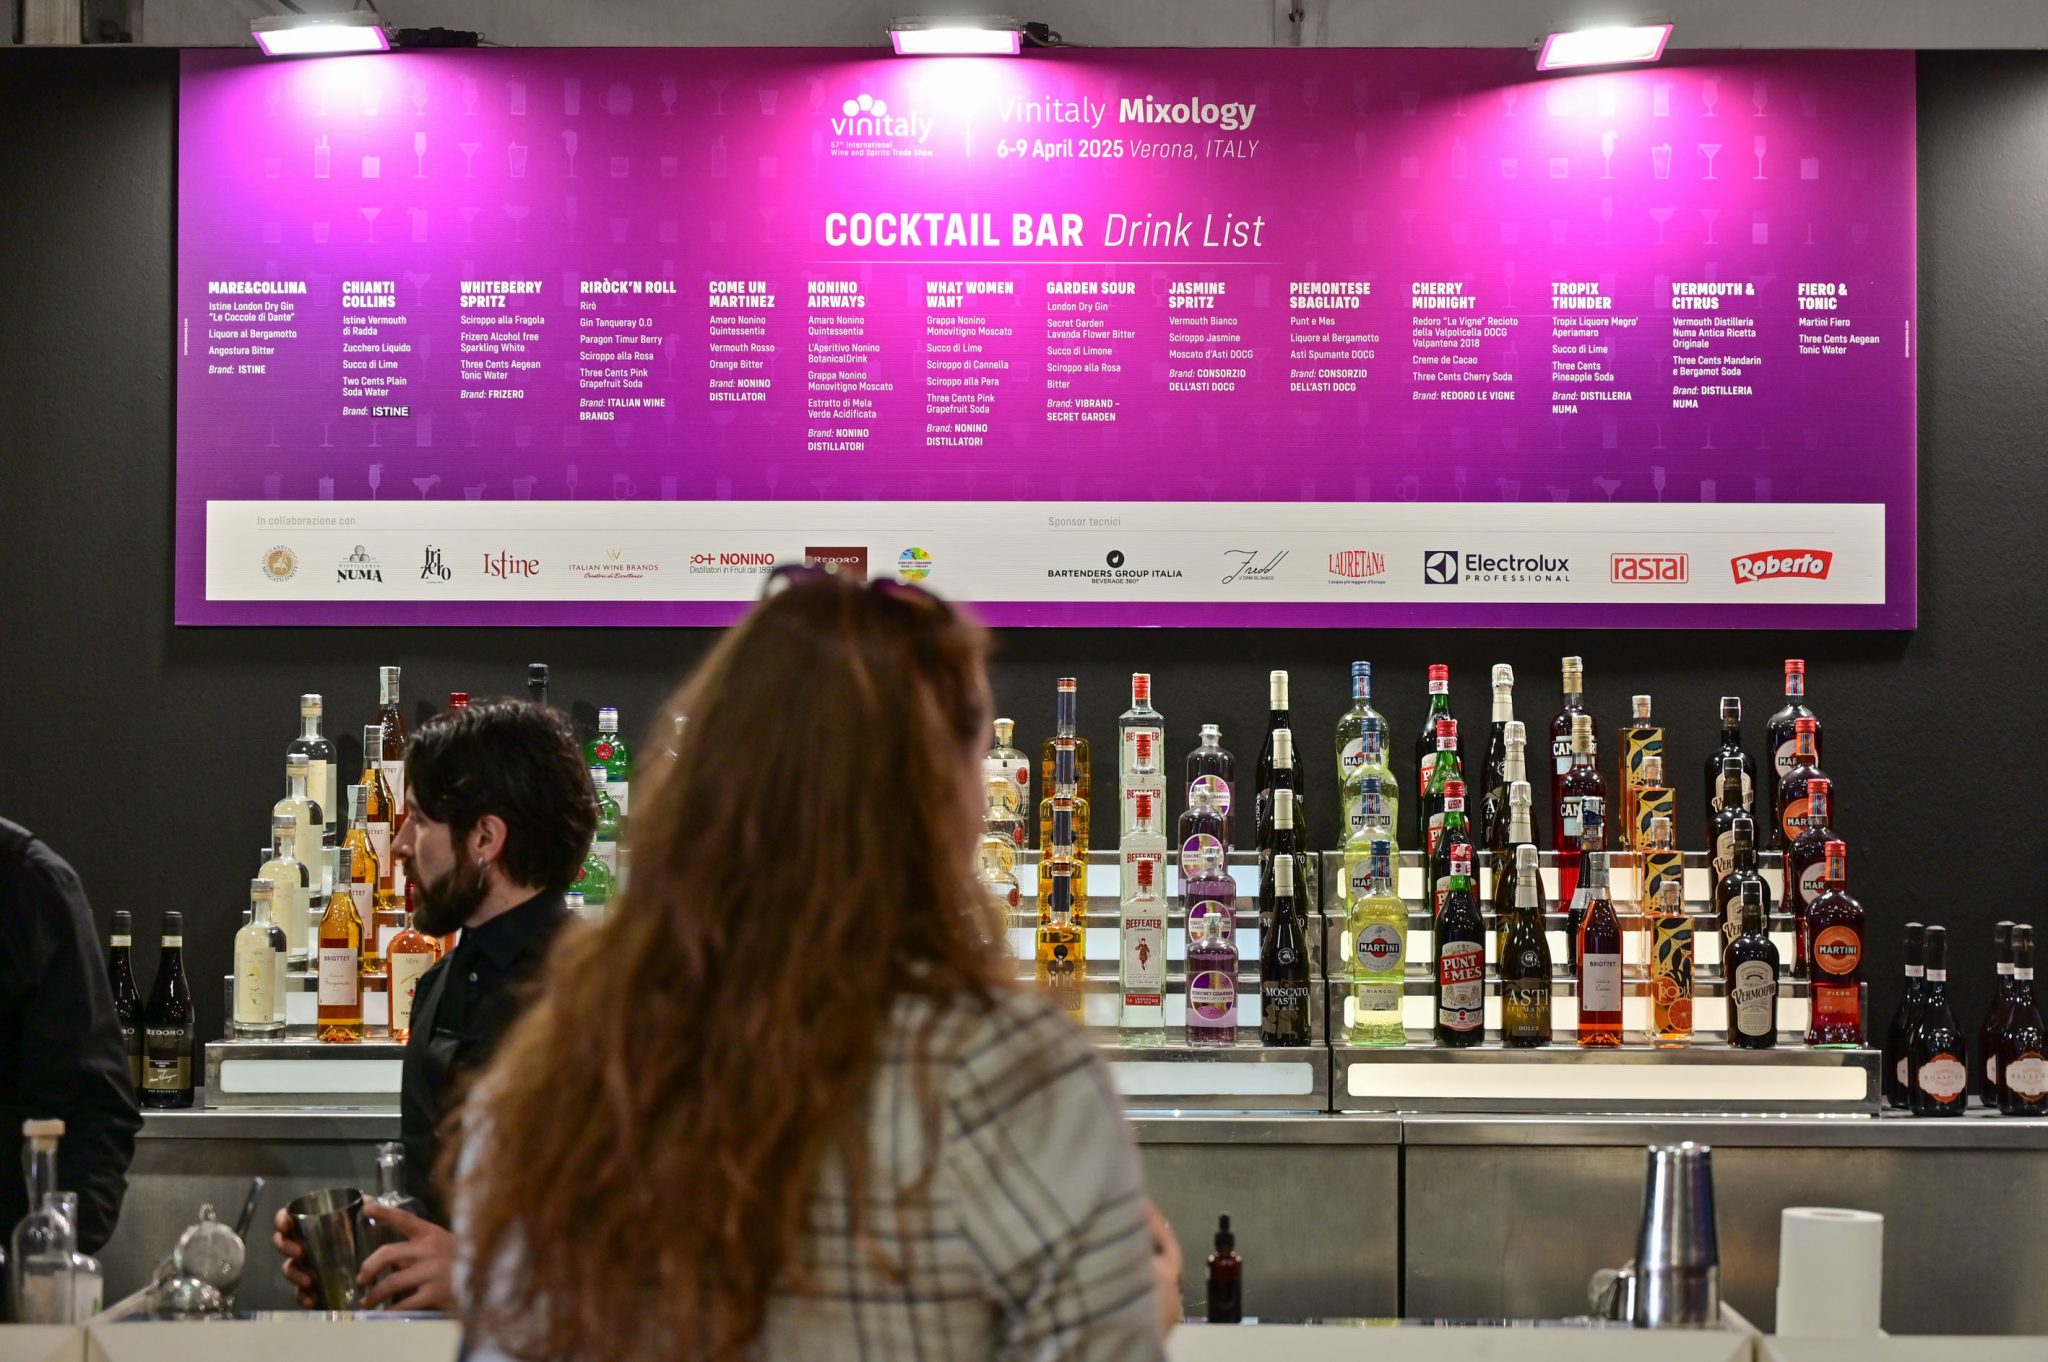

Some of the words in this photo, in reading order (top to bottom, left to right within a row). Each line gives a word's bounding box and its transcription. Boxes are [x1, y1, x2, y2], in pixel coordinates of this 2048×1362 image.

[1119, 94, 1256, 131] Mixology
[831, 111, 933, 143] vinitaly
[831, 149, 849, 157] Wine
[850, 149, 864, 157] and
[866, 149, 890, 158] Spirits
[892, 149, 912, 157] Trade
[914, 149, 934, 157] Show
[997, 139, 1028, 157] 6-9
[1032, 139, 1073, 161] April
[1078, 139, 1124, 158] 2025
[1130, 140, 1197, 160] Verona,
[1206, 140, 1259, 157] ITALY
[826, 213, 1000, 246] COCKTAIL
[1013, 214, 1083, 246] BAR
[1104, 213, 1192, 246] Drink
[1203, 213, 1265, 247] List
[209, 281, 307, 294] MARE&COLLINA
[343, 281, 394, 294] CHIANTI
[460, 281, 542, 293] WHITEBERRY
[645, 281, 676, 293] ROLL
[709, 281, 745, 293] COME
[749, 281, 766, 293] UN
[808, 281, 857, 293] NONINO
[925, 281, 963, 294] WHAT
[965, 282, 1013, 294] WOMEN
[1047, 282, 1098, 294] GARDEN
[1101, 282, 1135, 294] SOUR
[1169, 282, 1225, 294] JASMINE
[1290, 282, 1370, 294] PIEMONTESE
[1412, 282, 1463, 294] CHERRY
[1552, 283, 1599, 295] TROPIX
[1672, 283, 1742, 295] VERMOUTH
[1745, 283, 1754, 295] &
[1798, 283, 1835, 295] FIERO
[1838, 283, 1847, 295] &
[208, 301, 232, 311] Istine
[233, 301, 262, 311] London
[264, 301, 279, 313] Dry
[280, 301, 294, 311] Gin
[343, 295, 396, 307] COLLINS
[460, 295, 505, 307] SPRITZ
[709, 295, 775, 307] MARTINEZ
[808, 296, 865, 308] AIRWAYS
[925, 295, 963, 308] WANT
[1047, 301, 1076, 312] London
[1078, 301, 1093, 313] Dry
[1094, 301, 1108, 312] Gin
[1169, 296, 1214, 308] SPRITZ
[1290, 296, 1359, 308] SBAGLIATO
[1411, 296, 1476, 309] MIDNIGHT
[1552, 297, 1611, 309] THUNDER
[1672, 297, 1719, 309] CITRUS
[1798, 297, 1837, 309] TONIC
[460, 315, 496, 326] Sciroppo
[497, 315, 513, 325] alla
[514, 315, 544, 327] Fragola
[579, 317, 593, 328] Gin
[595, 317, 636, 329] Tanqueray
[638, 317, 652, 328] 0.0
[1290, 316, 1309, 326] Punt
[1311, 318, 1316, 326] e
[1318, 316, 1335, 326] Mes
[1798, 317, 1828, 327] Martini
[1829, 317, 1850, 327] Fiero
[342, 342, 380, 353] Zucchero
[381, 342, 411, 354] Liquido
[709, 342, 748, 353] Vermouth
[750, 342, 775, 353] Rosso
[1412, 338, 1458, 350] Valpantena
[1459, 338, 1480, 348] 2018
[1551, 344, 1577, 354] Succo
[1577, 344, 1586, 354] di
[1587, 344, 1608, 354] Lime
[1672, 338, 1709, 350] Originale
[1798, 344, 1820, 355] Tonic
[1821, 345, 1847, 355] Water
[1168, 349, 1203, 359] Moscato
[1229, 349, 1253, 359] DOCG
[208, 364, 234, 375] Brand:
[238, 364, 266, 375] ISTINE
[709, 359, 738, 371] Orange
[739, 359, 763, 369] Bitter
[926, 393, 949, 403] Three
[951, 393, 975, 403] Cents
[976, 393, 994, 403] Pink
[1672, 399, 1698, 409] NUMA
[342, 406, 368, 416] Brand:
[372, 406, 408, 417] ISTINE
[807, 409, 831, 419] Verde
[832, 408, 877, 419] Acidificata
[1046, 411, 1079, 422] SECRET
[1080, 412, 1116, 422] GARDEN
[807, 441, 864, 451] DISTILLATORI
[257, 516, 266, 526] In
[268, 516, 336, 526] collaborazione
[339, 517, 356, 526] con
[1048, 516, 1086, 528] Sponsor
[1090, 516, 1121, 527] tecnici
[483, 549, 540, 579] Istine
[720, 553, 775, 565] NONINO
[814, 556, 860, 564] REDORO
[1328, 550, 1386, 578] LAURETANA
[1466, 554, 1569, 572] Electrolux
[690, 566, 722, 574] Distillatori
[723, 566, 729, 574] in
[730, 566, 746, 574] Friuli
[746, 566, 756, 574] dal
[1048, 570, 1112, 578] BARTENDERS
[1115, 570, 1149, 578] GROUP
[1152, 570, 1183, 578] ITALIA
[1736, 554, 1824, 582] Roberto
[336, 569, 383, 583] NUMA
[1126, 918, 1162, 930] BEEFEATER
[1360, 943, 1398, 952] MARTINI
[1819, 945, 1857, 955] MARTINI
[1442, 954, 1477, 970] PUNT
[1452, 967, 1482, 985] MES
[1266, 986, 1308, 998] MOSCATO
[1508, 988, 1549, 1006] ASTI
[146, 1028, 184, 1036] REDORO
